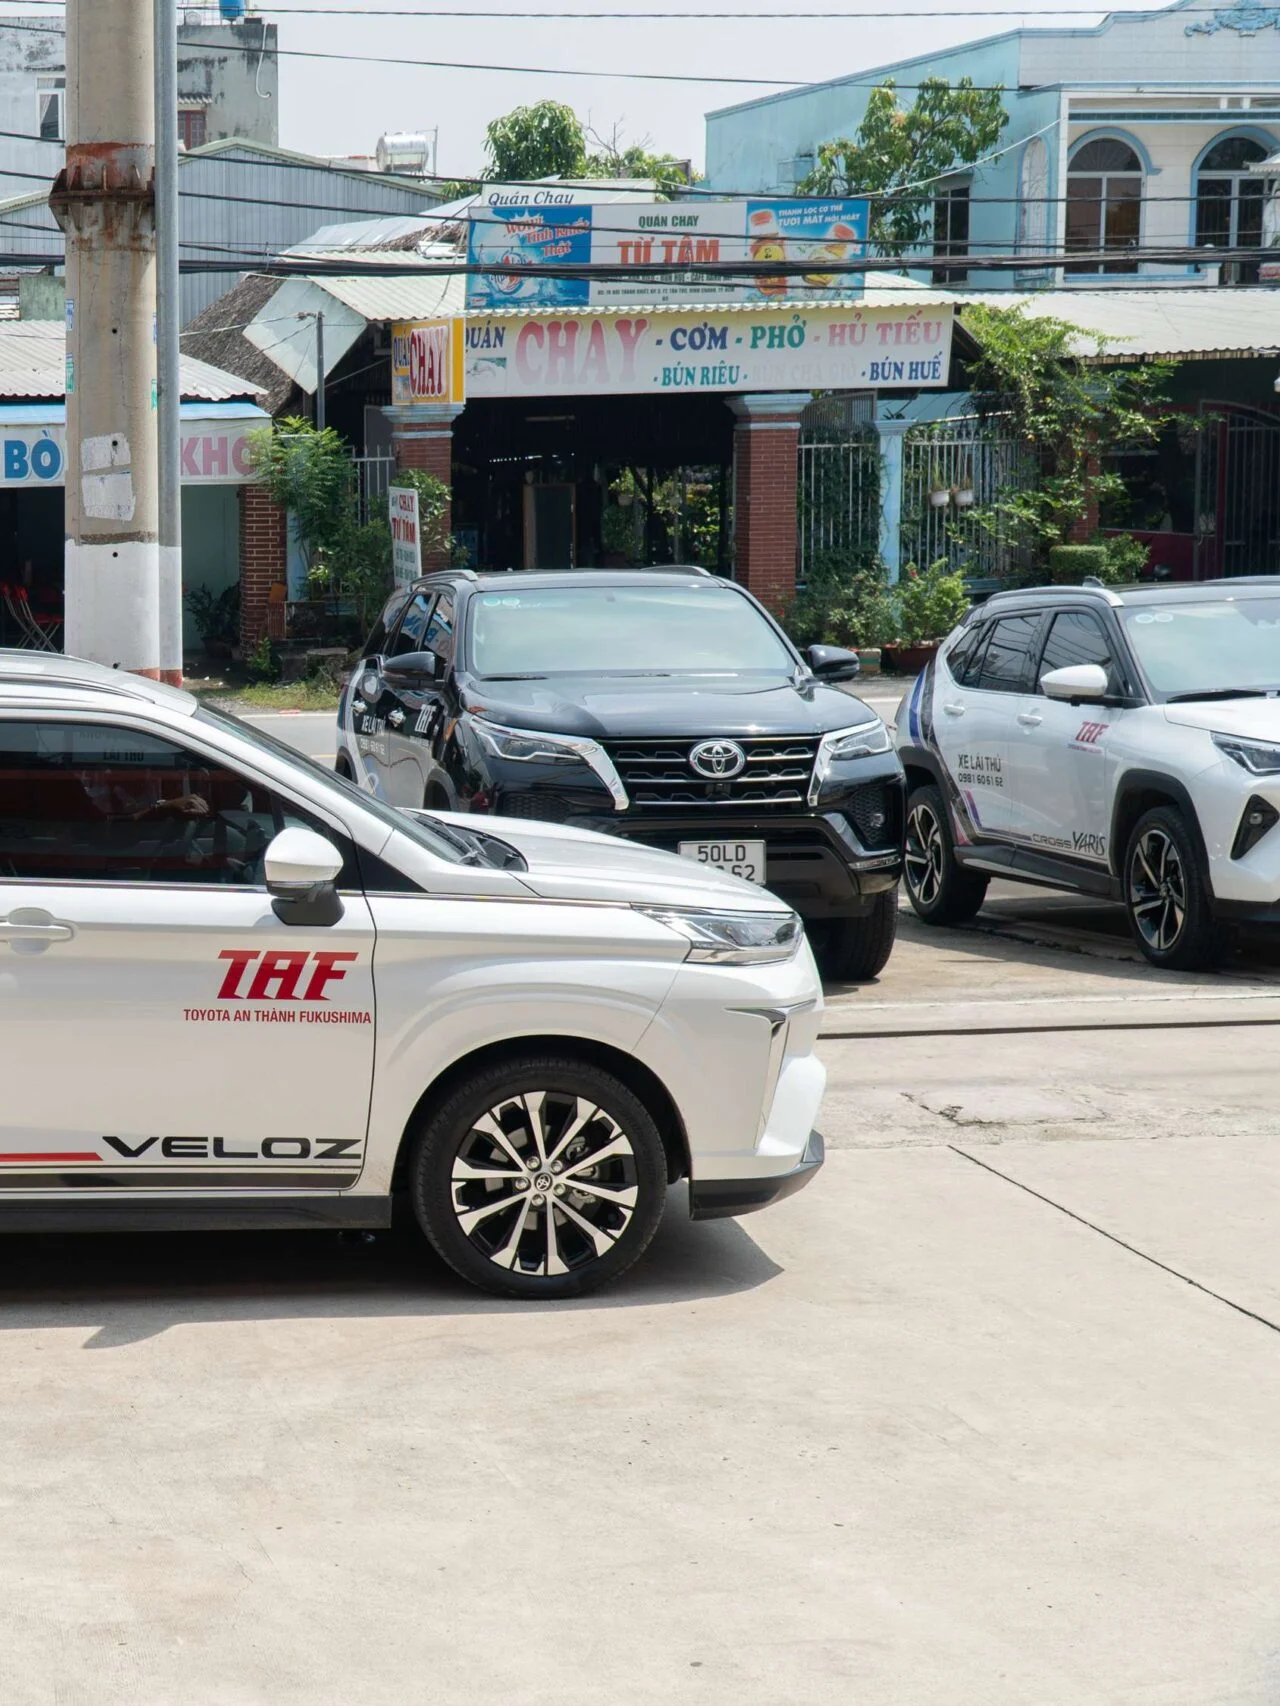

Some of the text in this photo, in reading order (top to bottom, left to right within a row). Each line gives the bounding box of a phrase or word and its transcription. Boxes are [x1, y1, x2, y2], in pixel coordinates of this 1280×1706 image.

[488, 191, 575, 206] Quán Chay
[638, 214, 699, 228] QUÁN CHAY
[661, 233, 720, 264] TÂM
[515, 319, 650, 385] CHAY
[670, 322, 728, 350] CƠM
[750, 314, 806, 349] PHỞ
[828, 312, 867, 347] HỦ
[876, 310, 942, 345] TIẾU
[409, 327, 448, 396] CHAY
[661, 361, 696, 386] BÚN
[700, 360, 740, 385] RIÊU
[869, 356, 904, 381] BÚN
[908, 352, 942, 380] HUẾ
[4, 430, 62, 481] BÒ
[1075, 720, 1110, 744] TAF
[958, 754, 969, 769] XE
[1031, 833, 1071, 849] CROSS
[698, 845, 746, 863] 50LD
[217, 949, 359, 1001] TAF
[184, 1007, 372, 1024] TOYOTA AN THÀNH FUKUSHIMA
[102, 1136, 362, 1160] VELOZ
